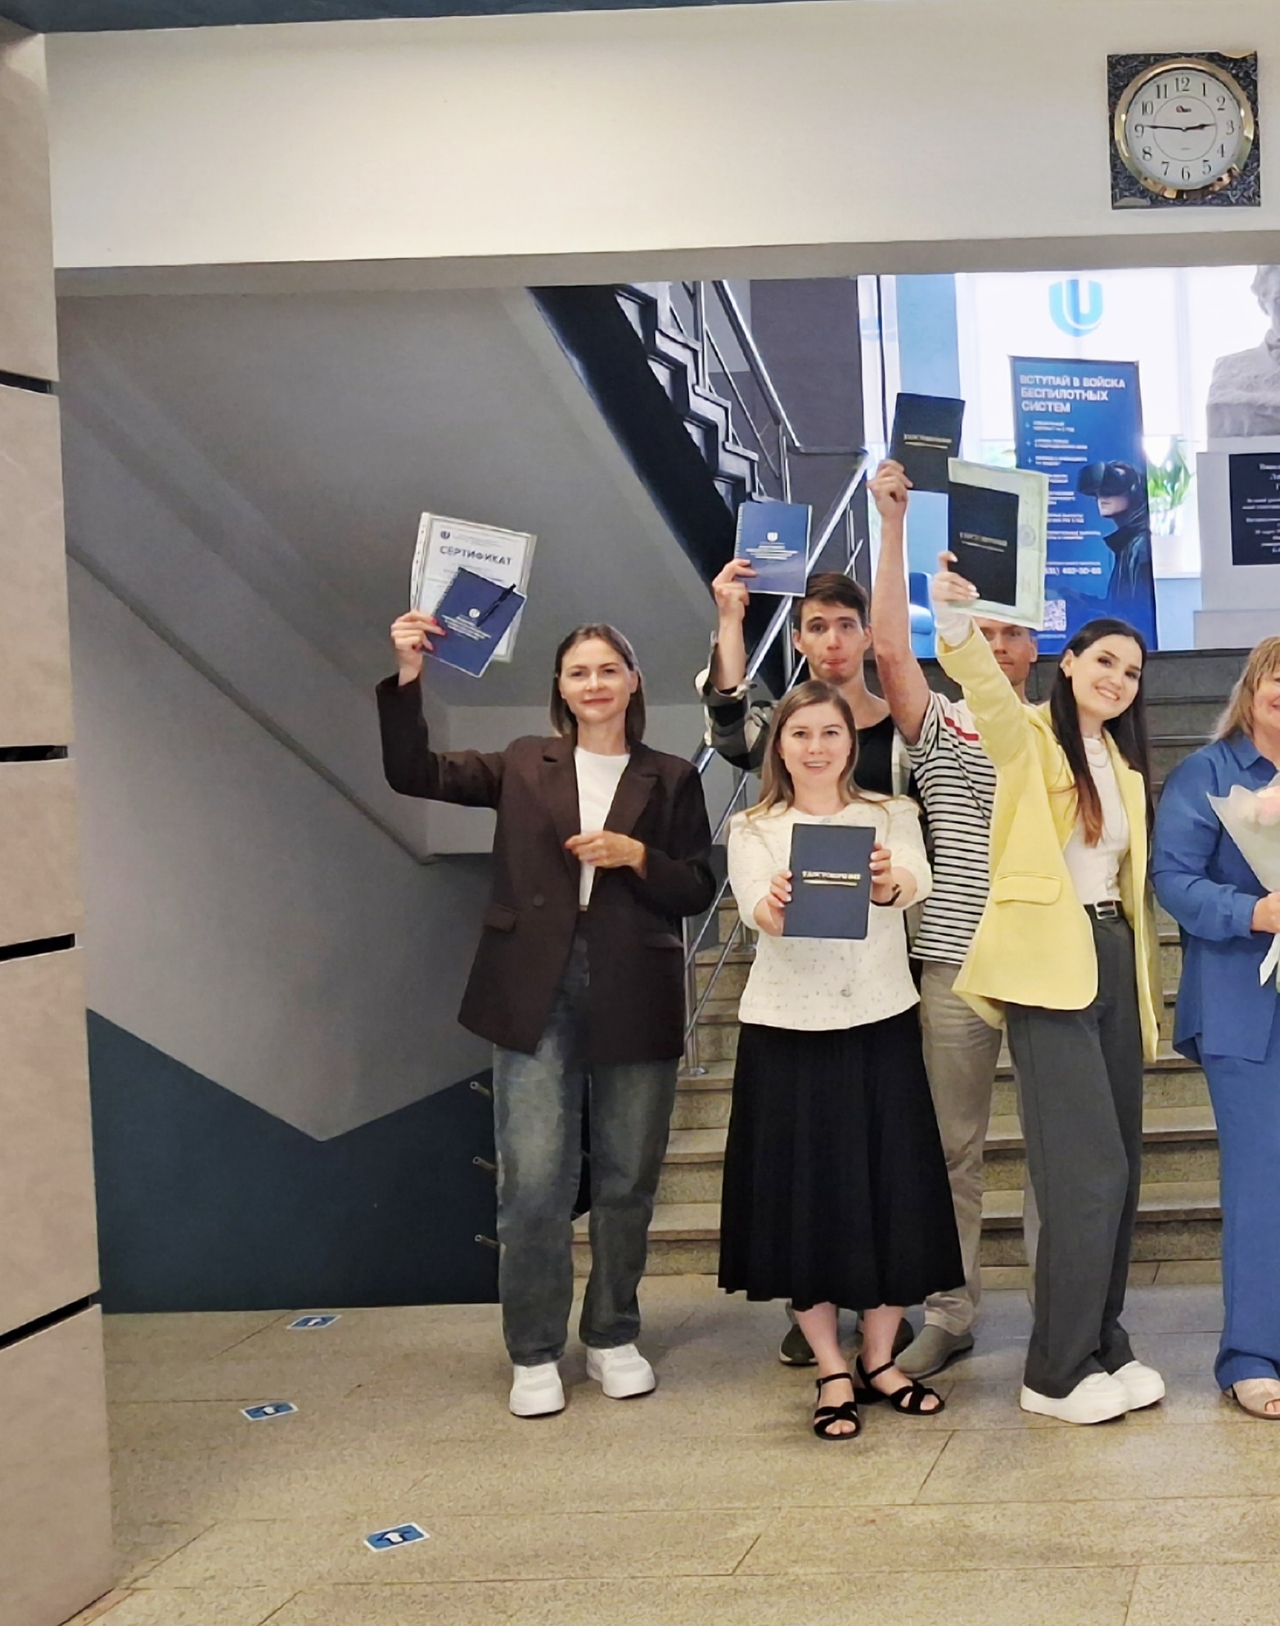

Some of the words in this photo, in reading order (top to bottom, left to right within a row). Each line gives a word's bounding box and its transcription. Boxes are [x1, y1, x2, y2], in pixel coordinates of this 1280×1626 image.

[1156, 84, 1168, 99] 11
[1174, 77, 1190, 92] 12
[1141, 101, 1154, 115] 10
[1216, 97, 1226, 111] 2
[1134, 124, 1145, 138] 9
[1226, 120, 1235, 135] 3
[1142, 146, 1152, 161] 8
[1217, 144, 1225, 158] 4
[1161, 161, 1170, 176] 7
[1181, 166, 1191, 181] 6
[1202, 160, 1212, 175] 5
[1020, 375, 1071, 387] ВСТУПАЙ
[1073, 377, 1080, 387] В
[1083, 376, 1126, 388] ВОЙСКА
[1021, 387, 1109, 401] БЕСПИЛОТНЫХ
[1021, 400, 1071, 413] СИСТЕМ
[439, 545, 513, 566] СЕРТИФИКАТ
